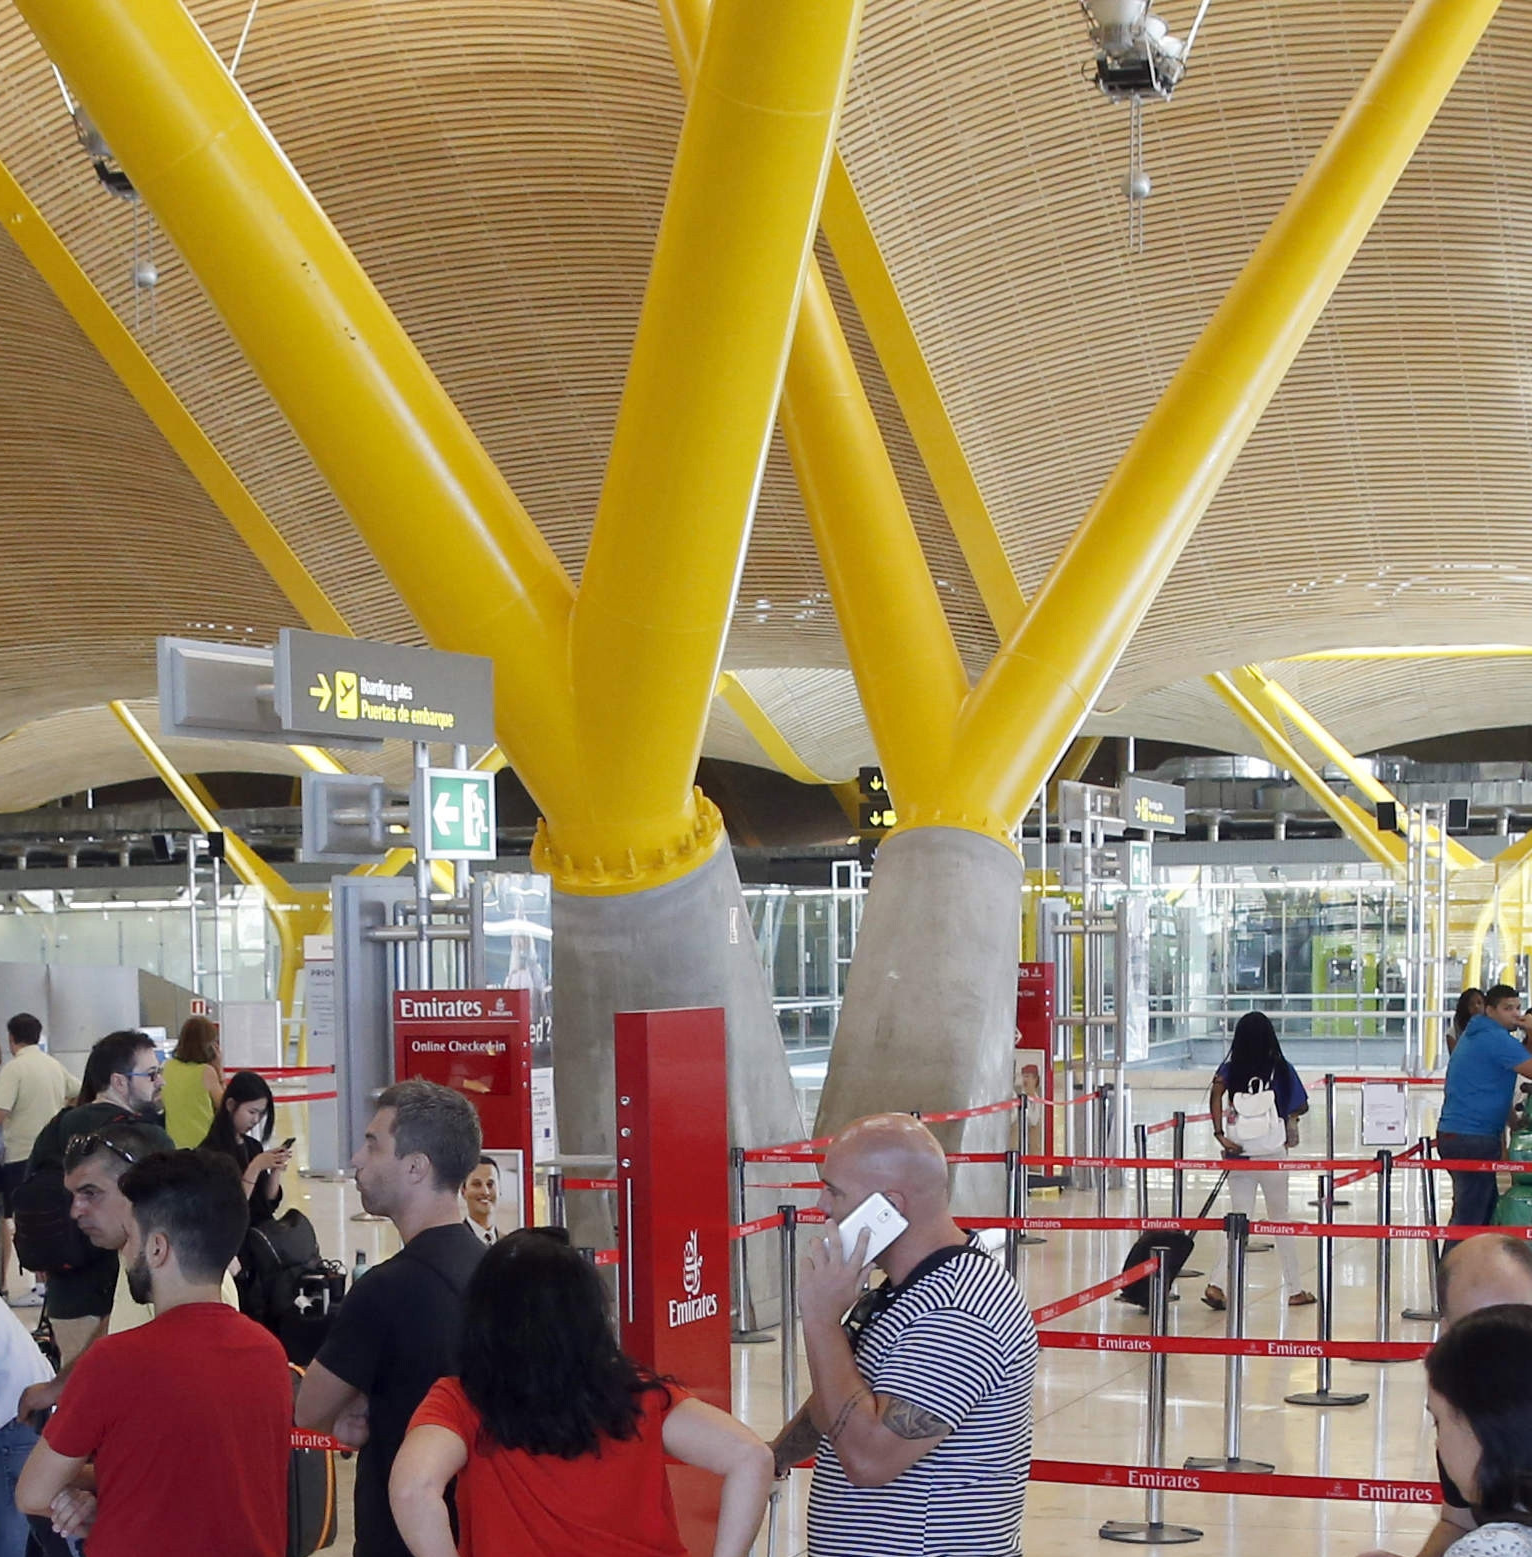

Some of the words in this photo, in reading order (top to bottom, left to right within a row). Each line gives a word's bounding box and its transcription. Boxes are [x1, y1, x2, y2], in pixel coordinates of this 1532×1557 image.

[360, 677, 392, 700] Boarding
[393, 683, 413, 702] gates
[361, 699, 396, 722] Puertas
[397, 704, 409, 723] de
[411, 707, 455, 731] embarque
[400, 997, 483, 1018] Emirates
[411, 1041, 446, 1052] Online
[1491, 1163, 1525, 1174] Emirates
[1023, 1219, 1062, 1229] Emirates
[1141, 1219, 1181, 1230] Emirates
[1253, 1223, 1295, 1235] Emirates
[1388, 1226, 1431, 1238] Emirates
[669, 1293, 718, 1328] Emirates
[1097, 1336, 1151, 1351] Emirates
[1267, 1341, 1324, 1357] Emirates
[1128, 1469, 1201, 1490] Emirates
[1357, 1481, 1433, 1503] Emirates
